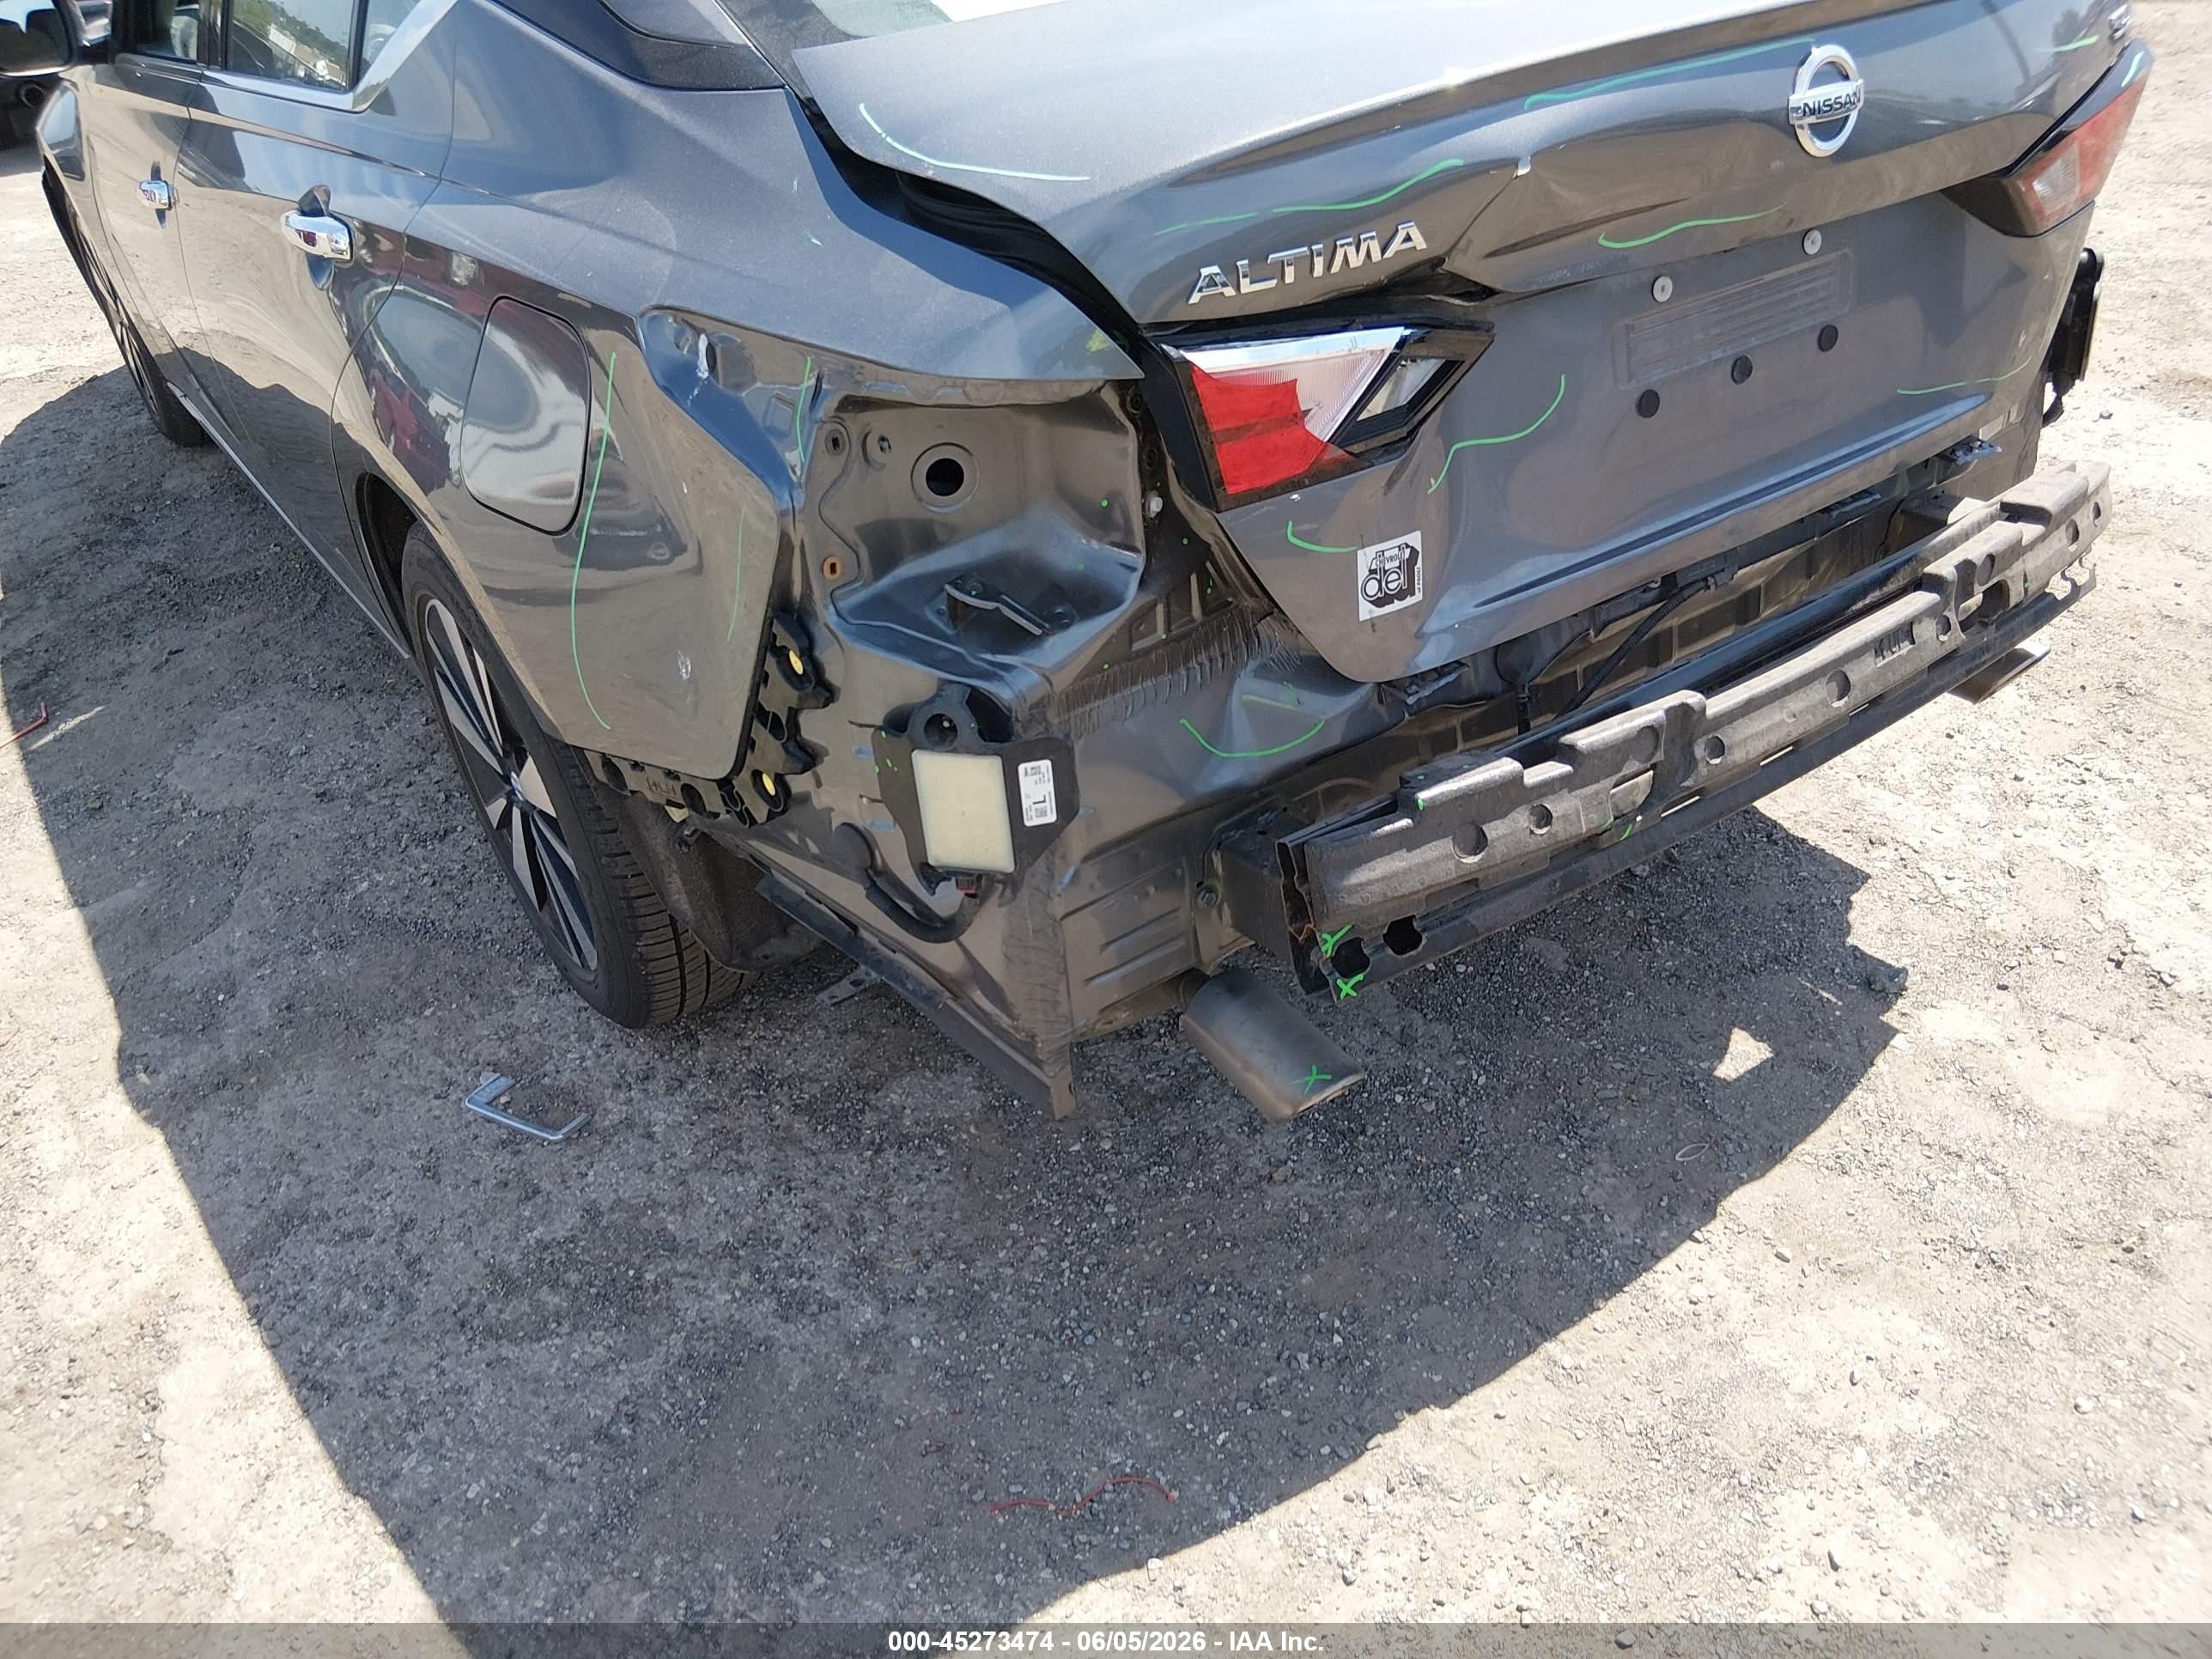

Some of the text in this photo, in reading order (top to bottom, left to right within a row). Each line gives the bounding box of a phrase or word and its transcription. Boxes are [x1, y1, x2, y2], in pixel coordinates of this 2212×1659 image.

[1802, 88, 1862, 117] NISSAN
[1188, 220, 1428, 306] ALTIMA
[1361, 544, 1407, 601] del
